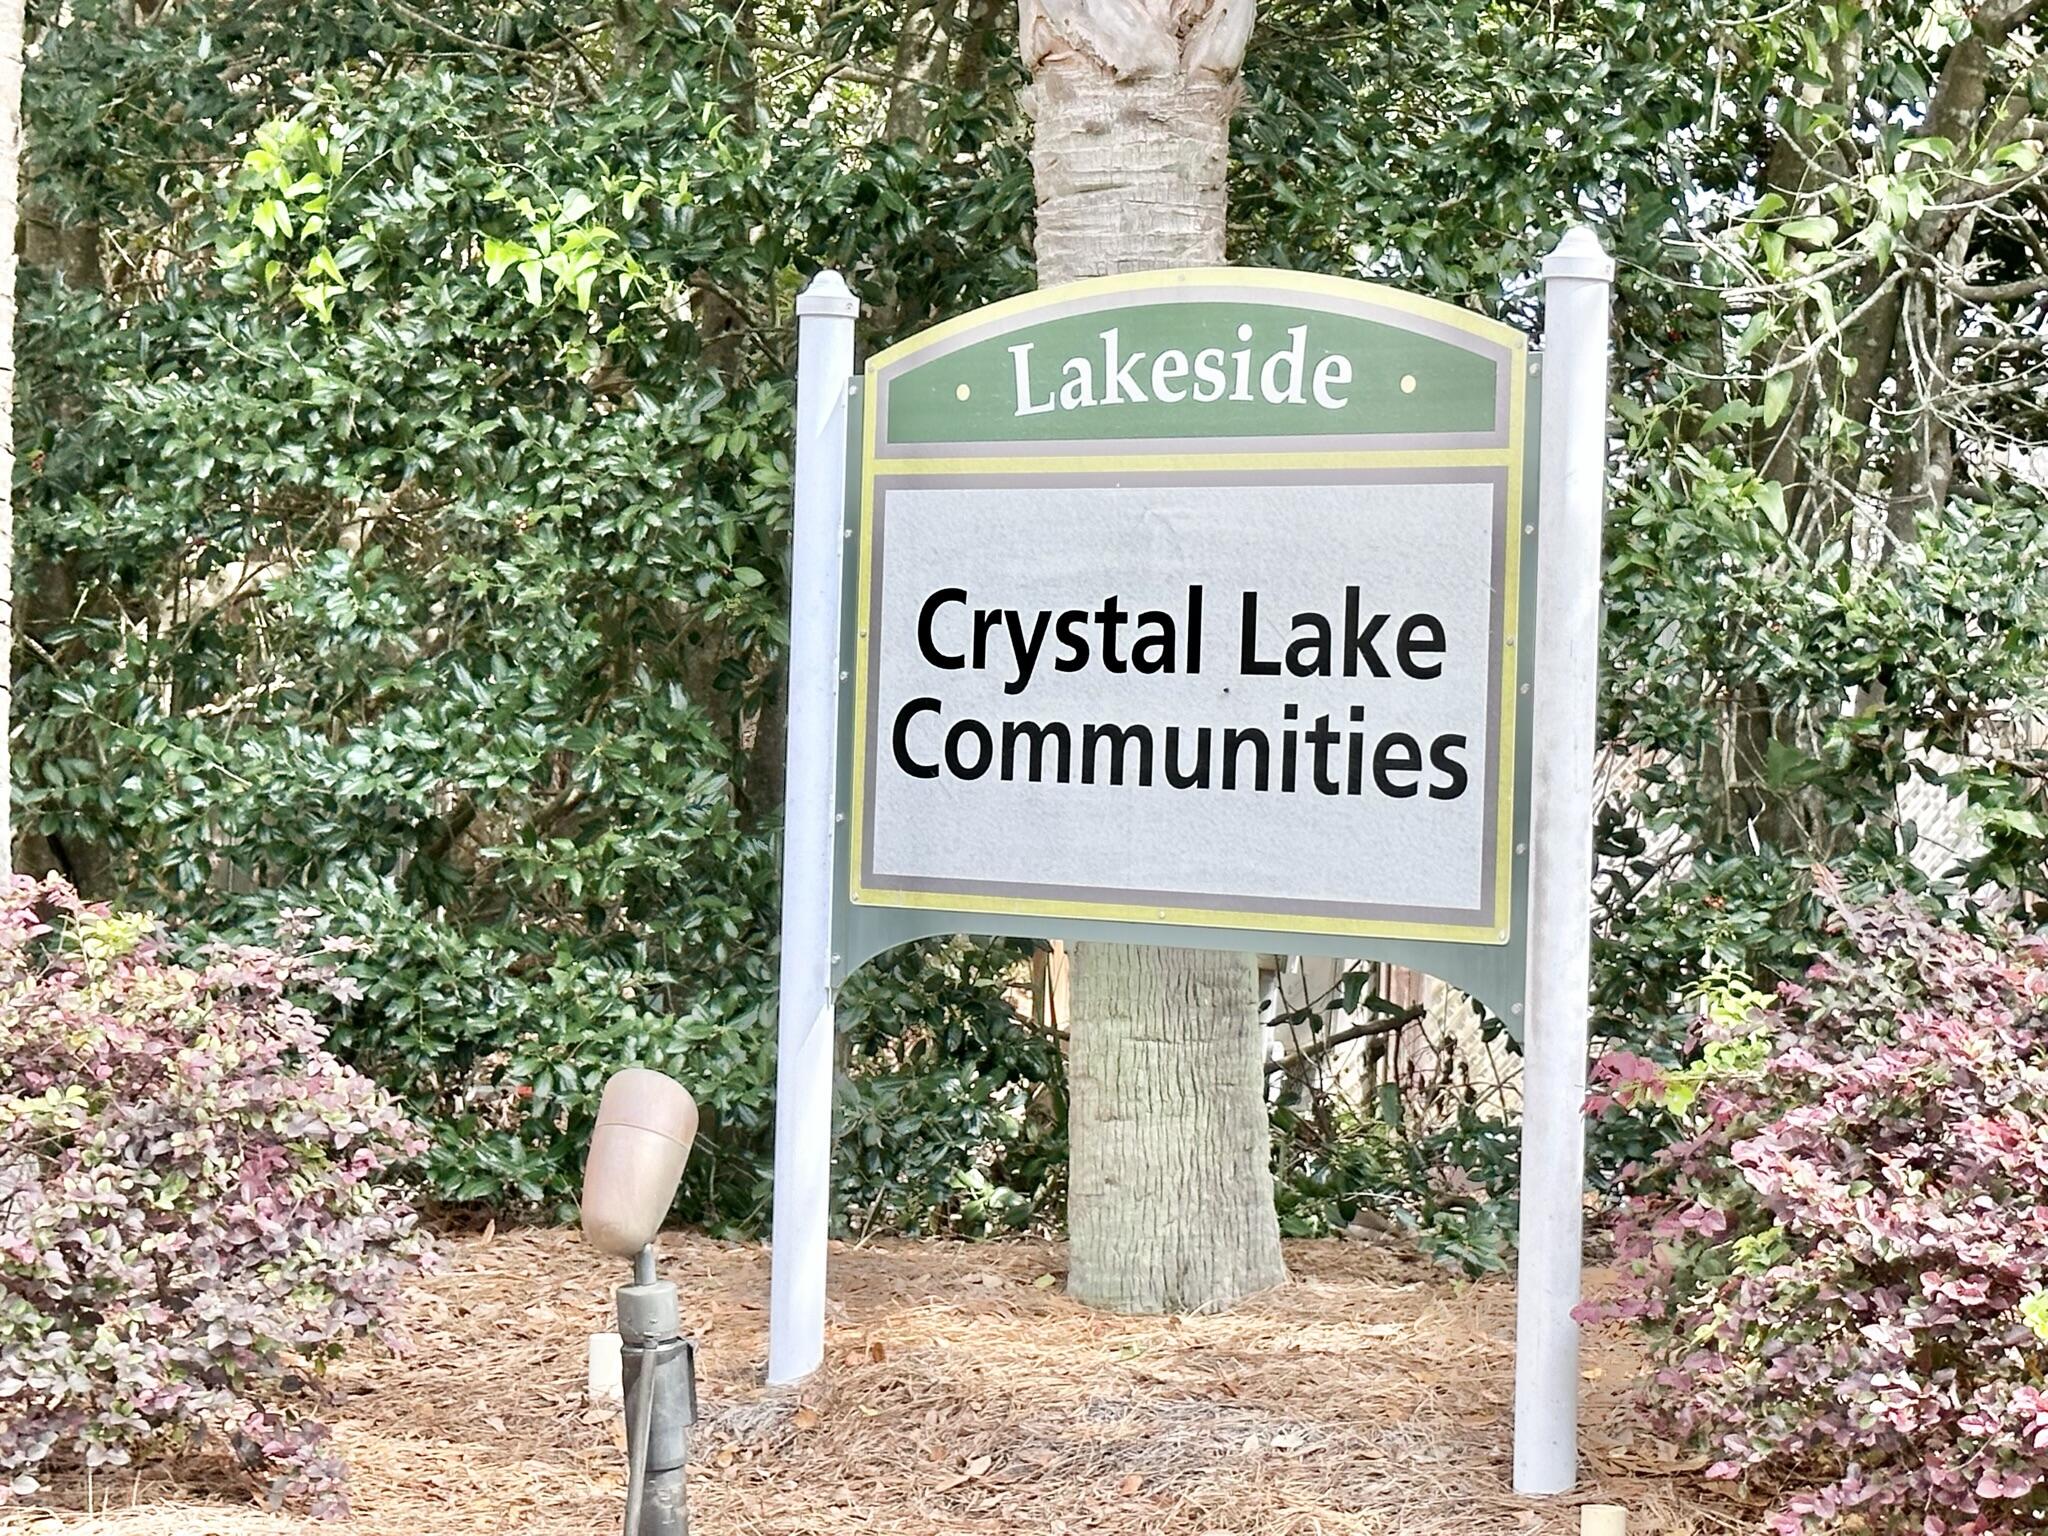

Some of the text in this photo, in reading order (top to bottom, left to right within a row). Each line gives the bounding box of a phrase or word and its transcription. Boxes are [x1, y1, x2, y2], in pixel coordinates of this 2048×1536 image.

[1007, 323, 1354, 418] Lakeside
[916, 584, 1448, 697] Crystal Lake
[891, 697, 1469, 801] Communities
